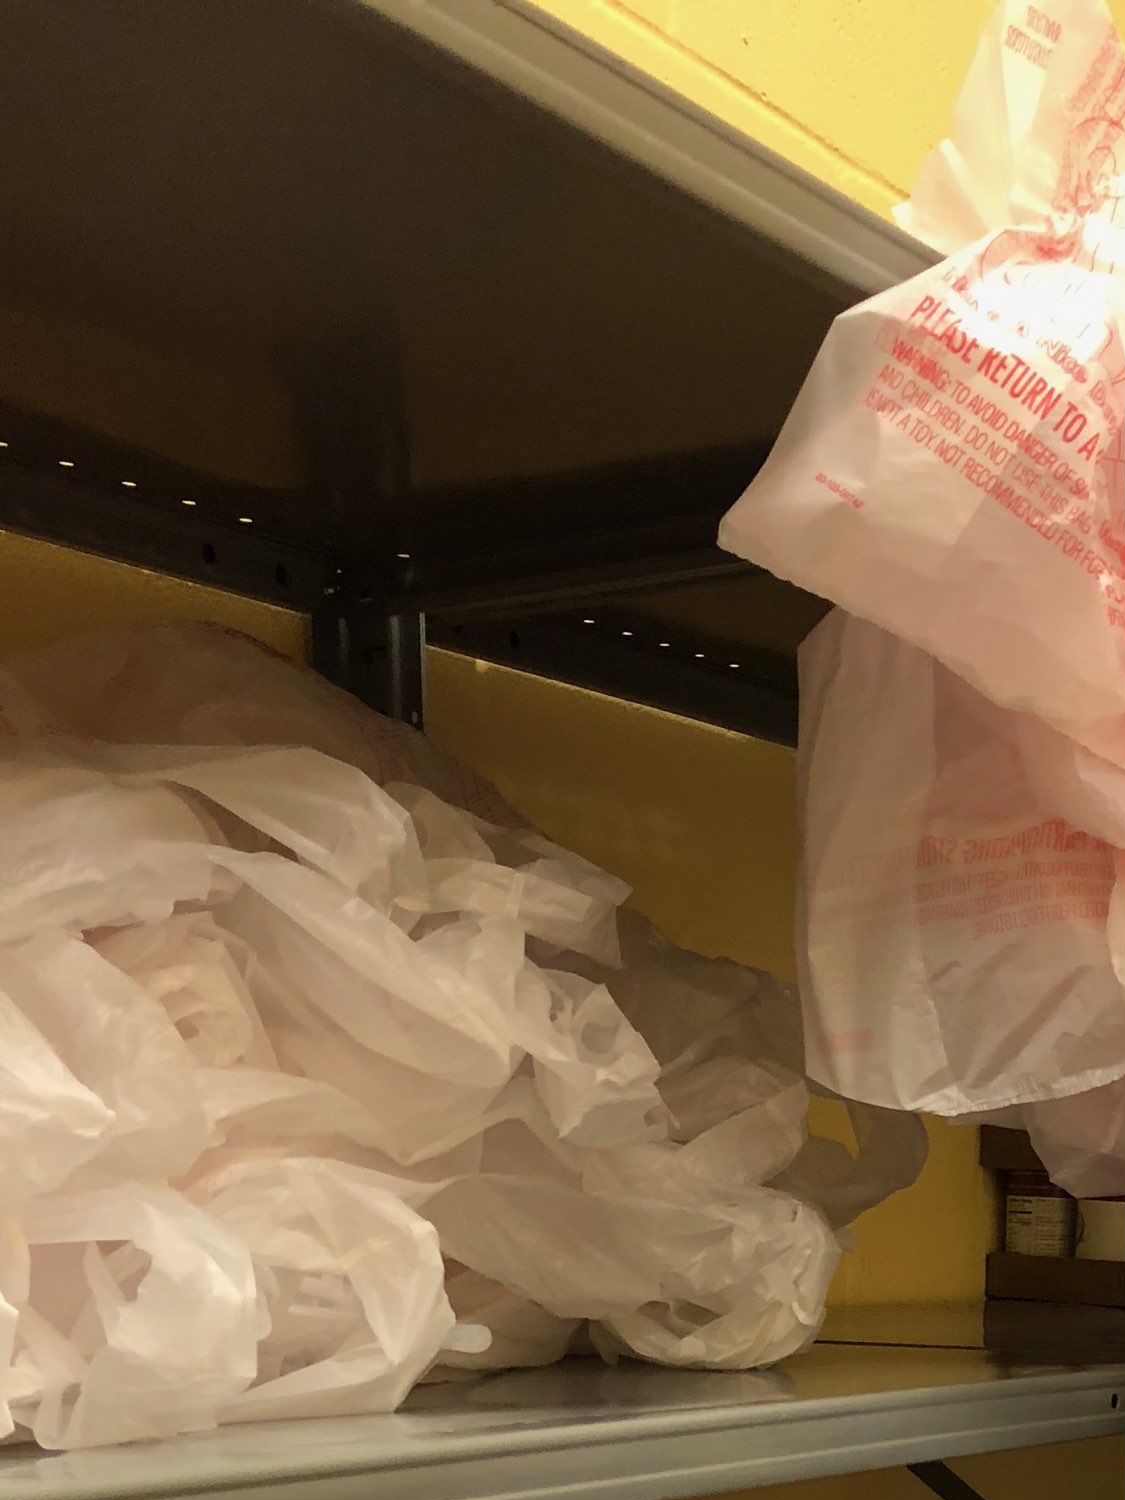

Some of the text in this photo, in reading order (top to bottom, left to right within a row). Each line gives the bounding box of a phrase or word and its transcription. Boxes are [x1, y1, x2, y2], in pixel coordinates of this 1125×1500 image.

[911, 296, 978, 362] PLEASE
[978, 349, 1060, 418] RETURN
[1053, 402, 1086, 442] TO
[896, 414, 910, 430] A
[934, 439, 965, 466] NOT
[1055, 529, 1083, 559] FOR
[951, 380, 970, 404] TO
[967, 395, 1007, 430] AVOID
[1003, 421, 1057, 466] DANGER
[1052, 462, 1073, 483] OF
[964, 425, 987, 450] DO
[985, 441, 1015, 469] NOT
[1012, 463, 1041, 488] USE
[1039, 484, 1068, 512] THIS
